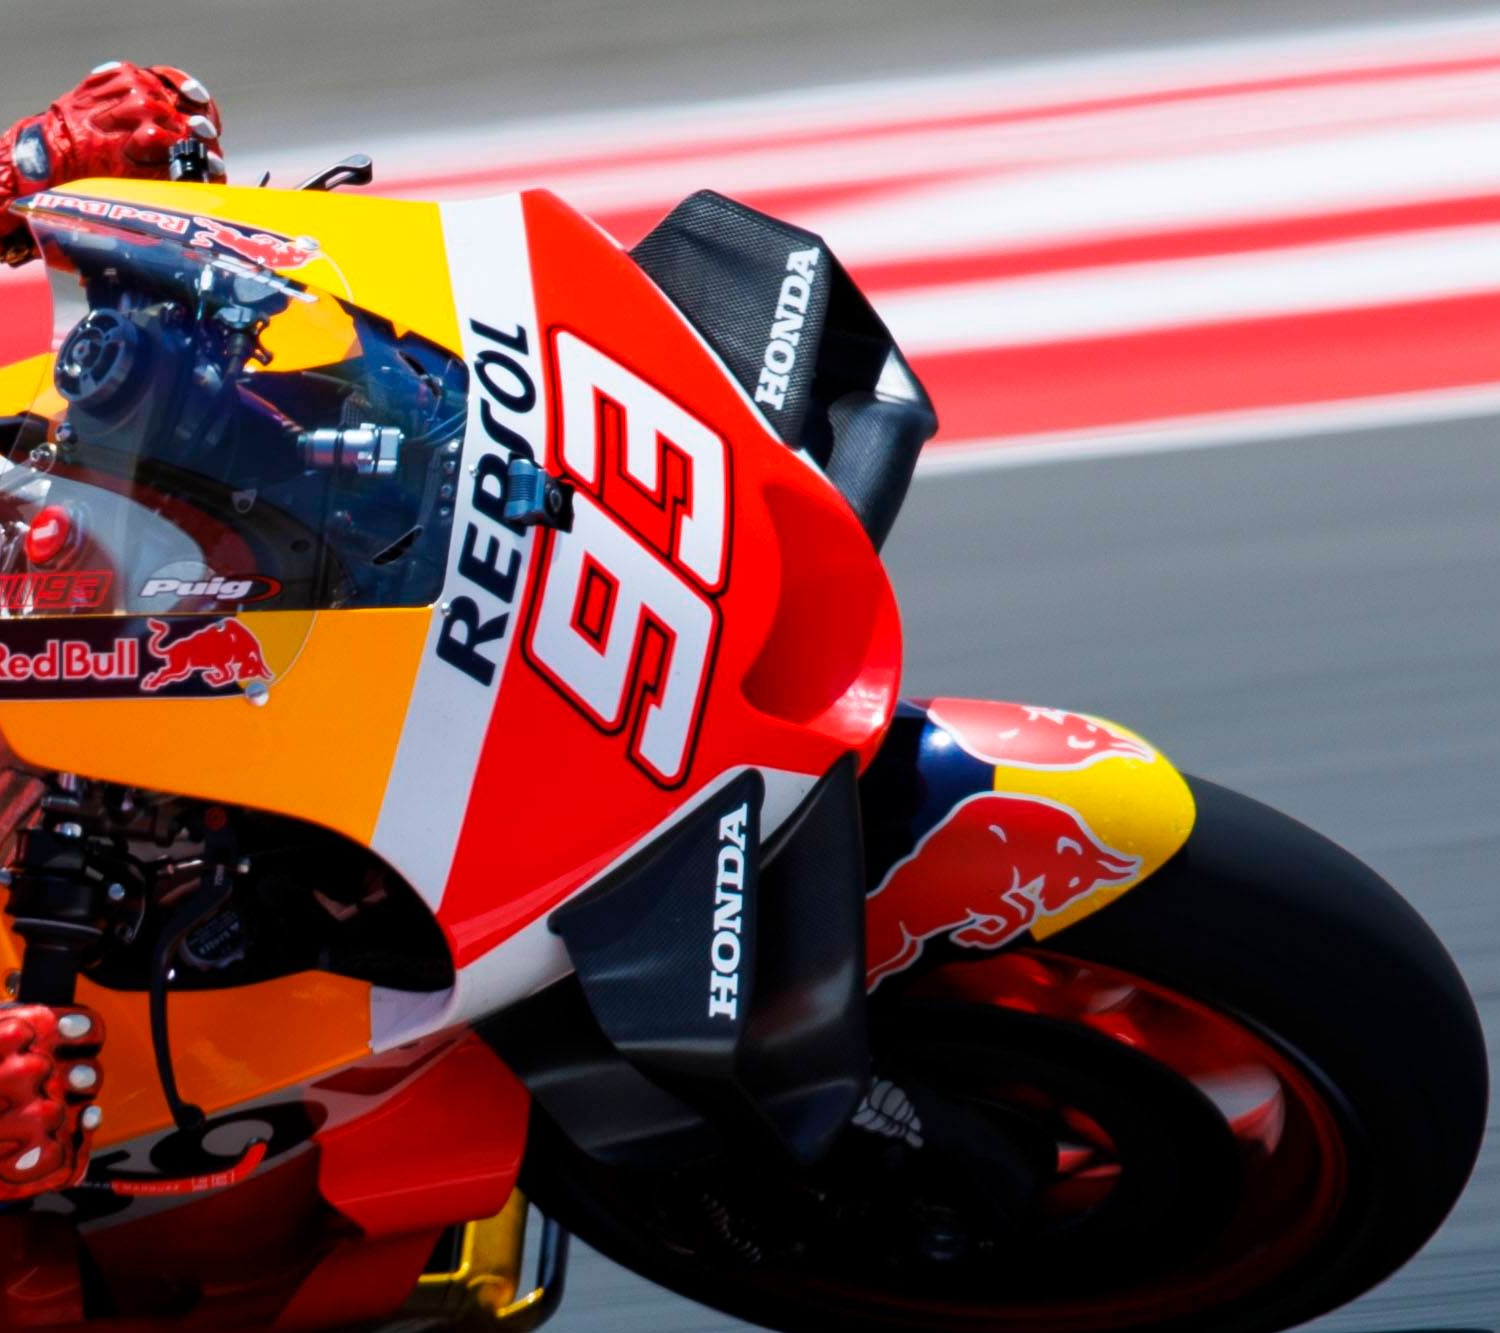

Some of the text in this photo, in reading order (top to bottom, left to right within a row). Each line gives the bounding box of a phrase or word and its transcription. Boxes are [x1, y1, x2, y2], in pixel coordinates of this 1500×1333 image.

[27, 193, 192, 236] Red Bull
[755, 246, 820, 410] HONDA
[435, 317, 540, 688] REPSOL
[522, 322, 734, 790] 93
[63, 638, 139, 679] Bull
[140, 577, 253, 600] Puig
[708, 803, 748, 1020] HONDA
